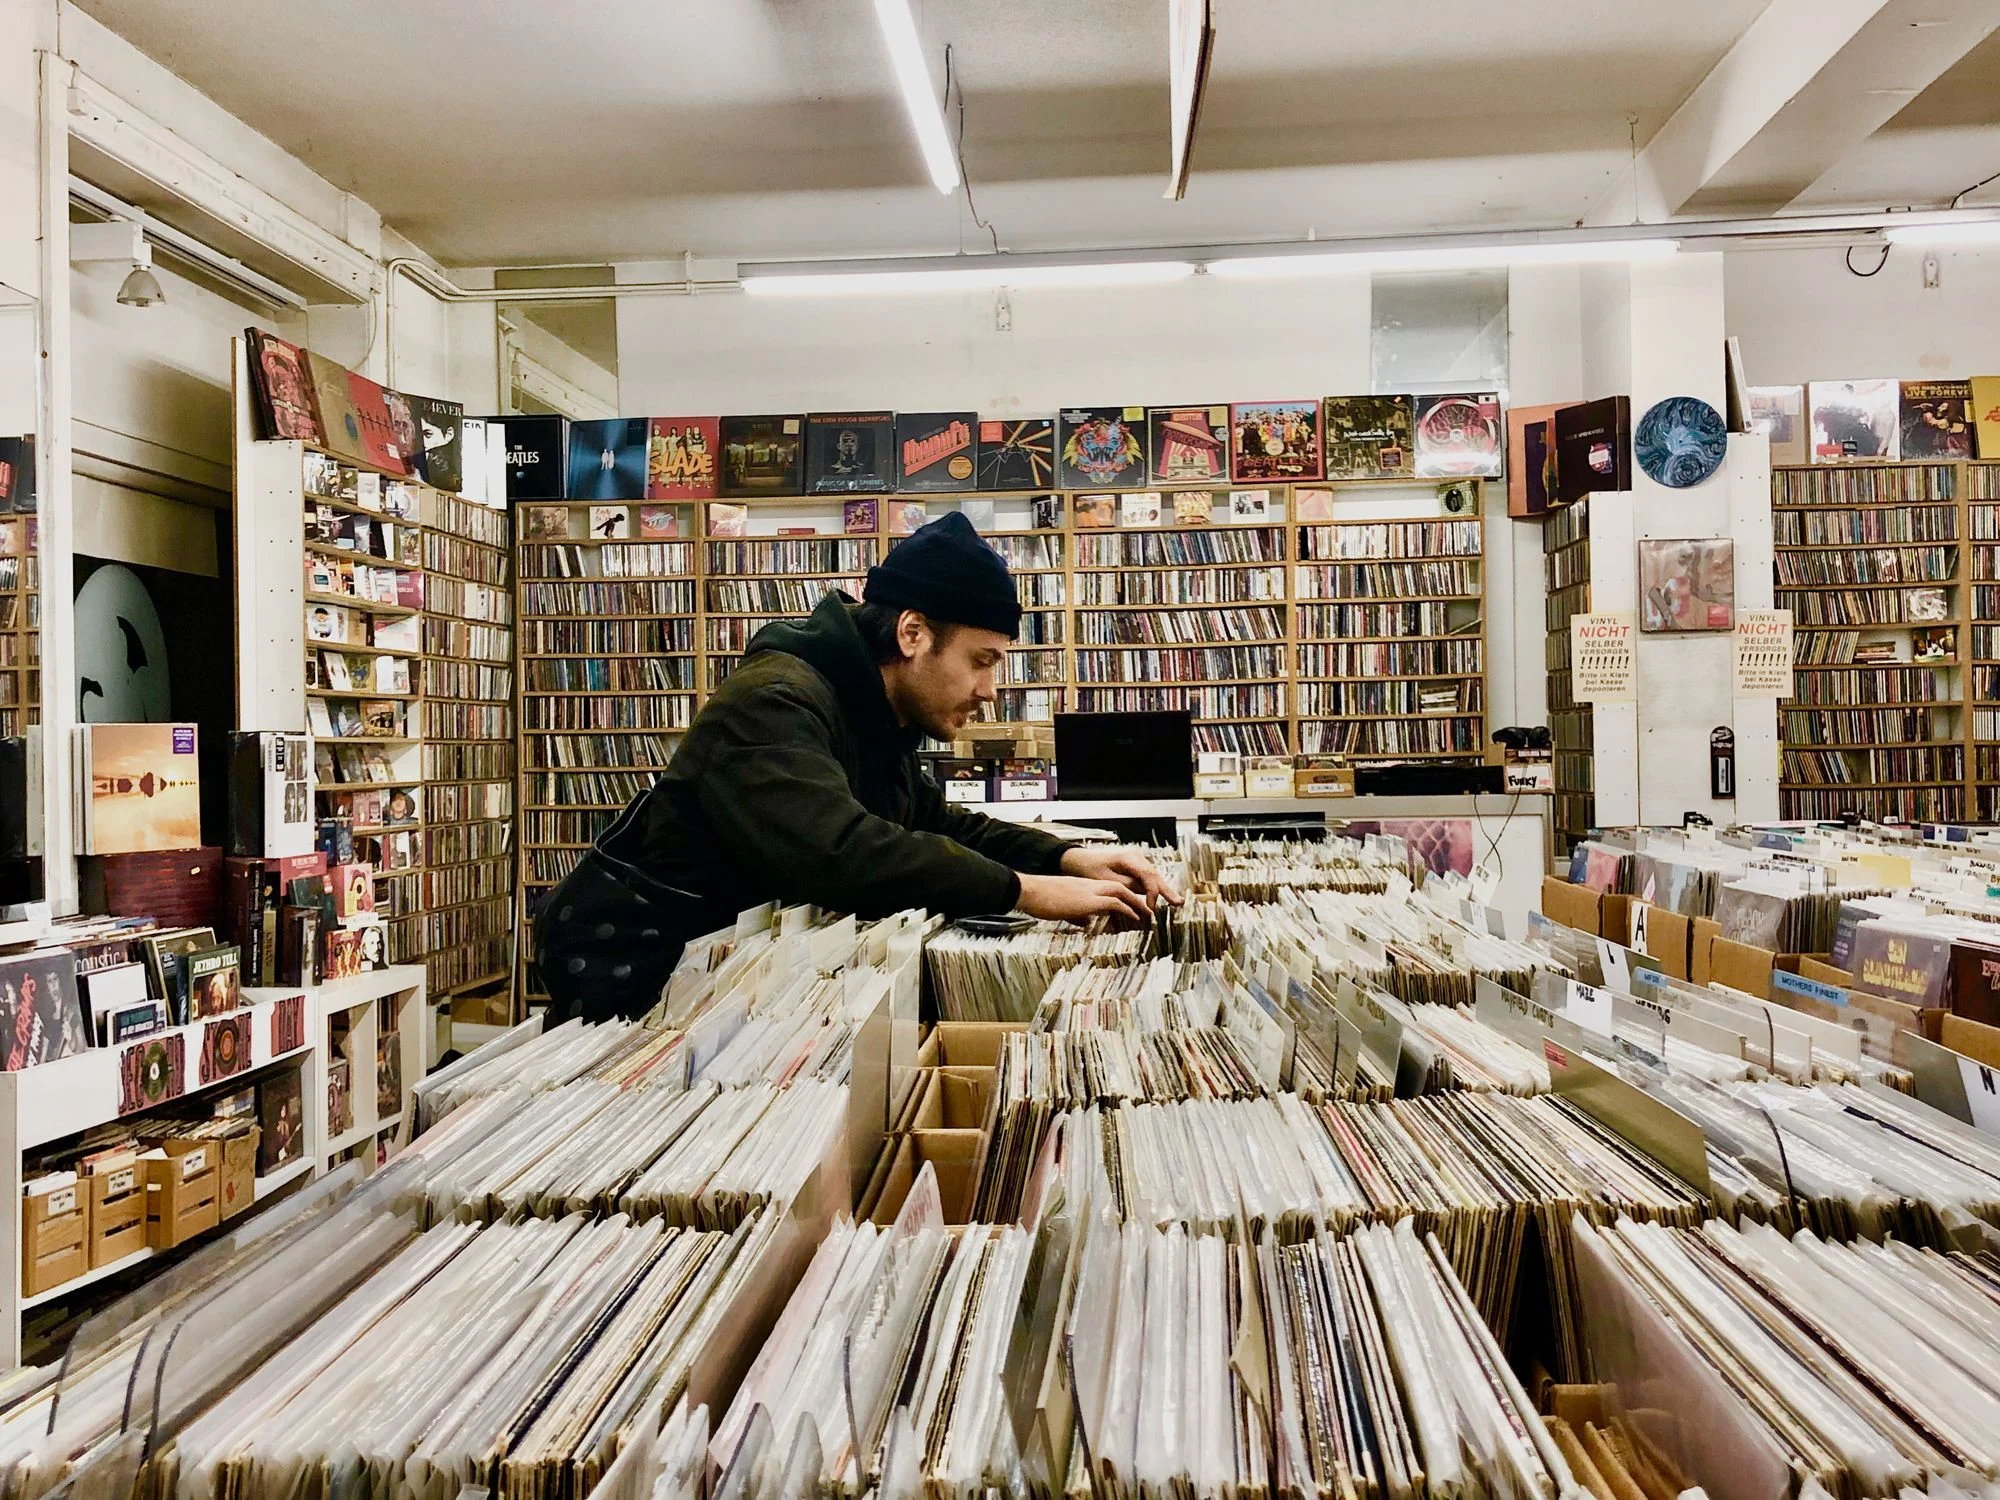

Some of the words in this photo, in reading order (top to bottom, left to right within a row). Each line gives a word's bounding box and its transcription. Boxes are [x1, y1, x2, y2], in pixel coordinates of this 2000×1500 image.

[506, 451, 540, 466] EATLES
[649, 446, 714, 475] SLADE
[1749, 614, 1777, 622] VINYL
[1579, 626, 1630, 638] NICHT
[1739, 623, 1788, 635] NICHT
[75, 946, 121, 972] coustic
[193, 956, 222, 974] JETHRO
[221, 953, 238, 967] TULL
[1781, 976, 1813, 993] MOTHERS
[1815, 986, 1840, 1000] FINEST
